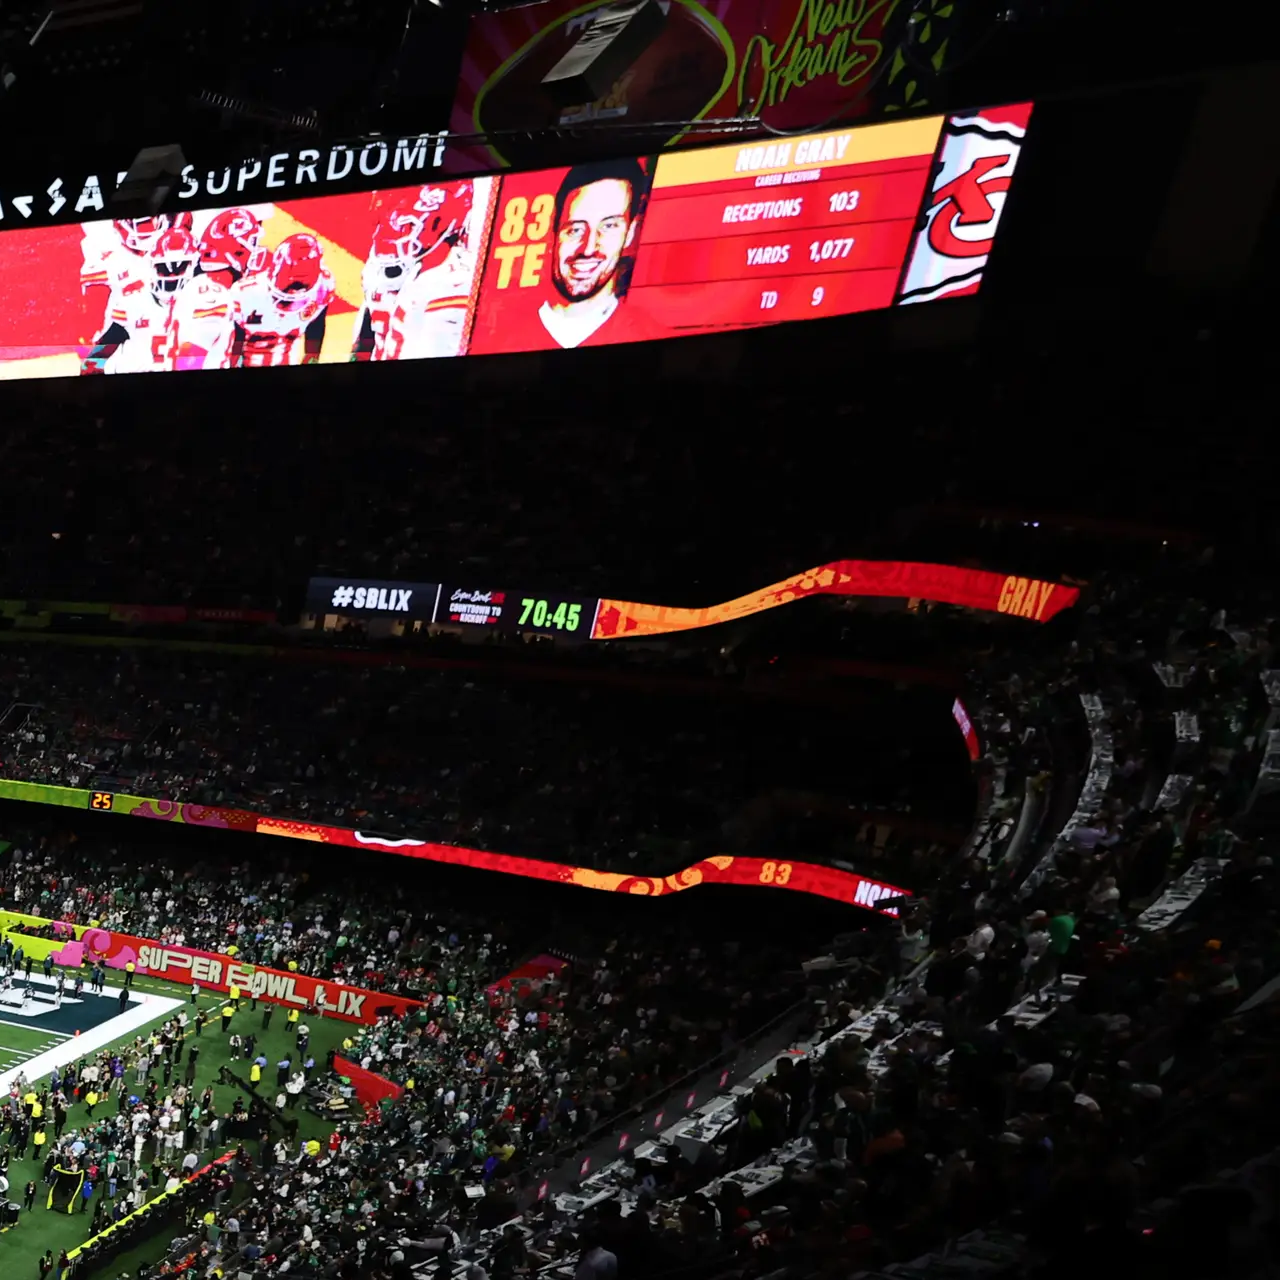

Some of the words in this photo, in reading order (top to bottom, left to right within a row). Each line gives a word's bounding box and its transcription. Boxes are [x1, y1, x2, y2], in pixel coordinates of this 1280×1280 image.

[735, 143, 793, 172] NOAH
[794, 134, 852, 165] GRAY
[500, 194, 554, 243] 83
[722, 197, 803, 223] RECEPTIONS
[828, 190, 860, 213] 103
[493, 245, 544, 290] TE
[746, 244, 791, 266] YARDS
[809, 238, 854, 263] 1,077
[760, 291, 778, 309] TD
[810, 286, 825, 306] 9
[332, 586, 412, 612] #SBLIX
[997, 575, 1056, 620] GRAY
[518, 598, 581, 631] 70:45
[92, 793, 112, 809] 25
[759, 862, 792, 885] 83
[138, 946, 223, 984] SUPER
[225, 965, 308, 1005] BOWL
[315, 985, 367, 1018] LIX
